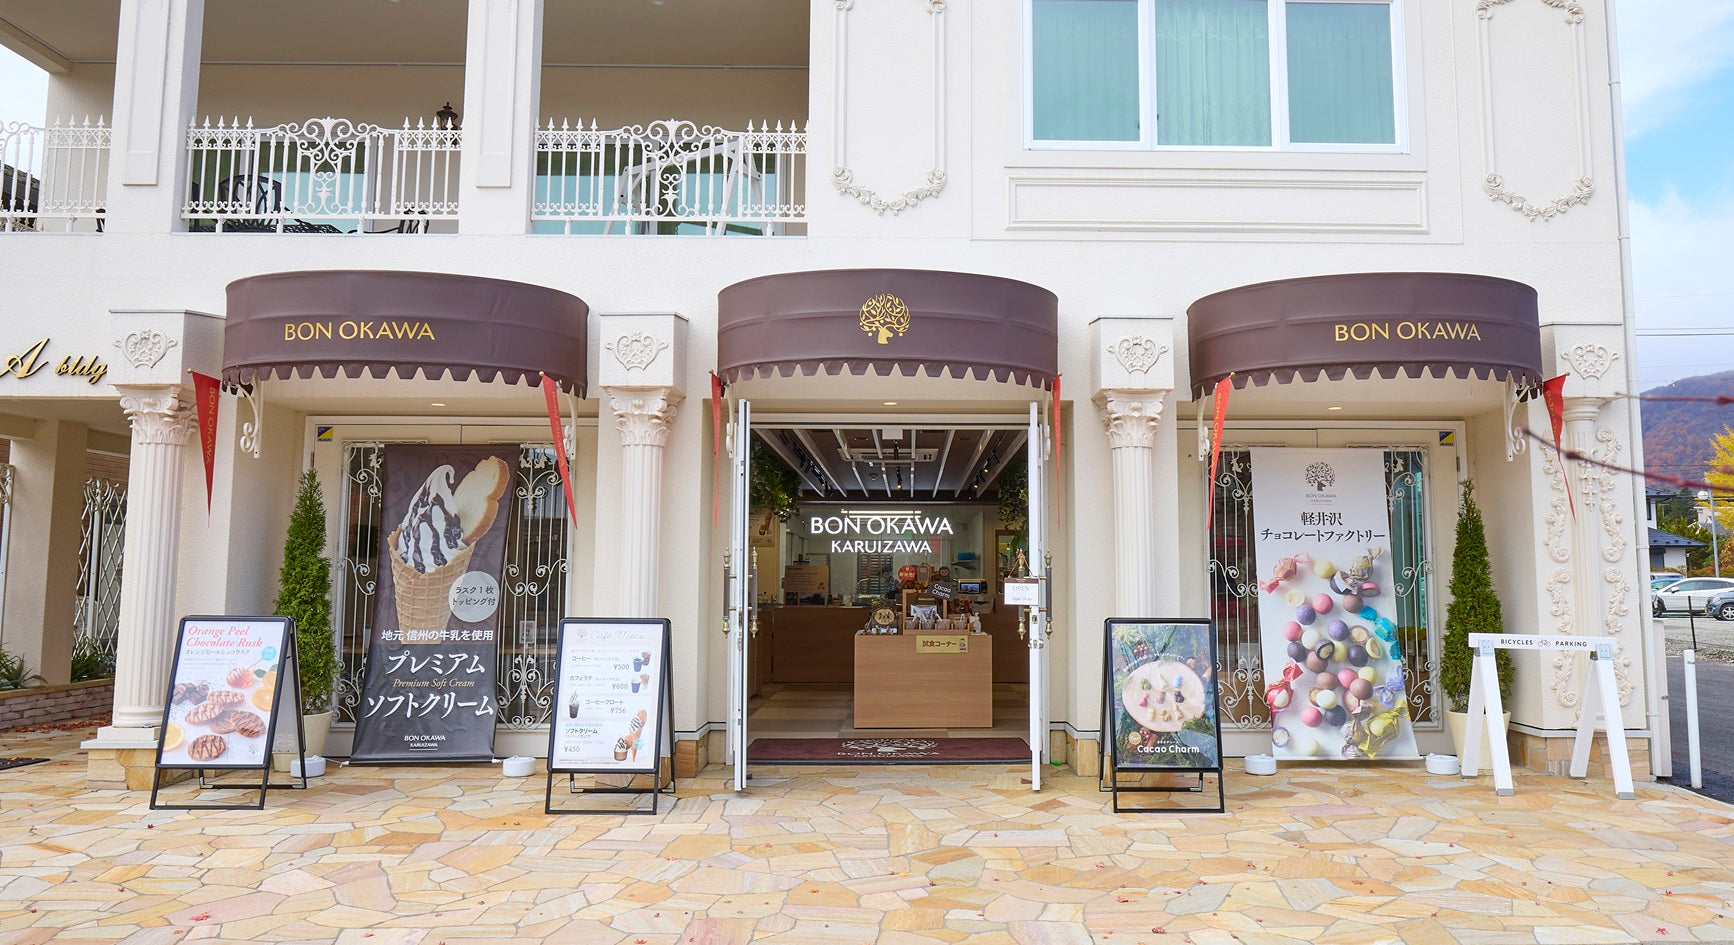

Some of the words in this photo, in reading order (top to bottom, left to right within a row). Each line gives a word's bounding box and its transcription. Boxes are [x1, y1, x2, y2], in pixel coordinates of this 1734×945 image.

[284, 321, 332, 341] BON
[339, 321, 436, 341] OKAWA
[1334, 322, 1390, 342] BON
[1396, 321, 1482, 342] OKAWA
[0, 337, 50, 379] A
[55, 355, 108, 385] bldg
[208, 387, 216, 415] BON
[206, 417, 214, 464] OKAWA
[810, 516, 860, 535] BON
[867, 515, 954, 535] OKAWA
[1301, 511, 1343, 526] 軽井沢
[1261, 528, 1386, 543] チョコレートファクトリー
[831, 540, 932, 553] KARUIZAWA
[452, 597, 496, 606] トッピング付
[188, 626, 225, 638] Orange
[227, 626, 251, 636] Peel
[381, 629, 404, 641] 地元
[406, 629, 494, 641] 信州の牛乳を使用
[186, 637, 235, 648] Chocolate
[237, 637, 263, 648] Rusk
[386, 650, 485, 676] プレミアム
[393, 679, 429, 688] Premium
[431, 678, 447, 690] Soft
[449, 679, 475, 688] Cream
[364, 692, 494, 719] ソフトクリーム
[1137, 745, 1167, 753] Cacao
[1168, 744, 1200, 753] Charm
